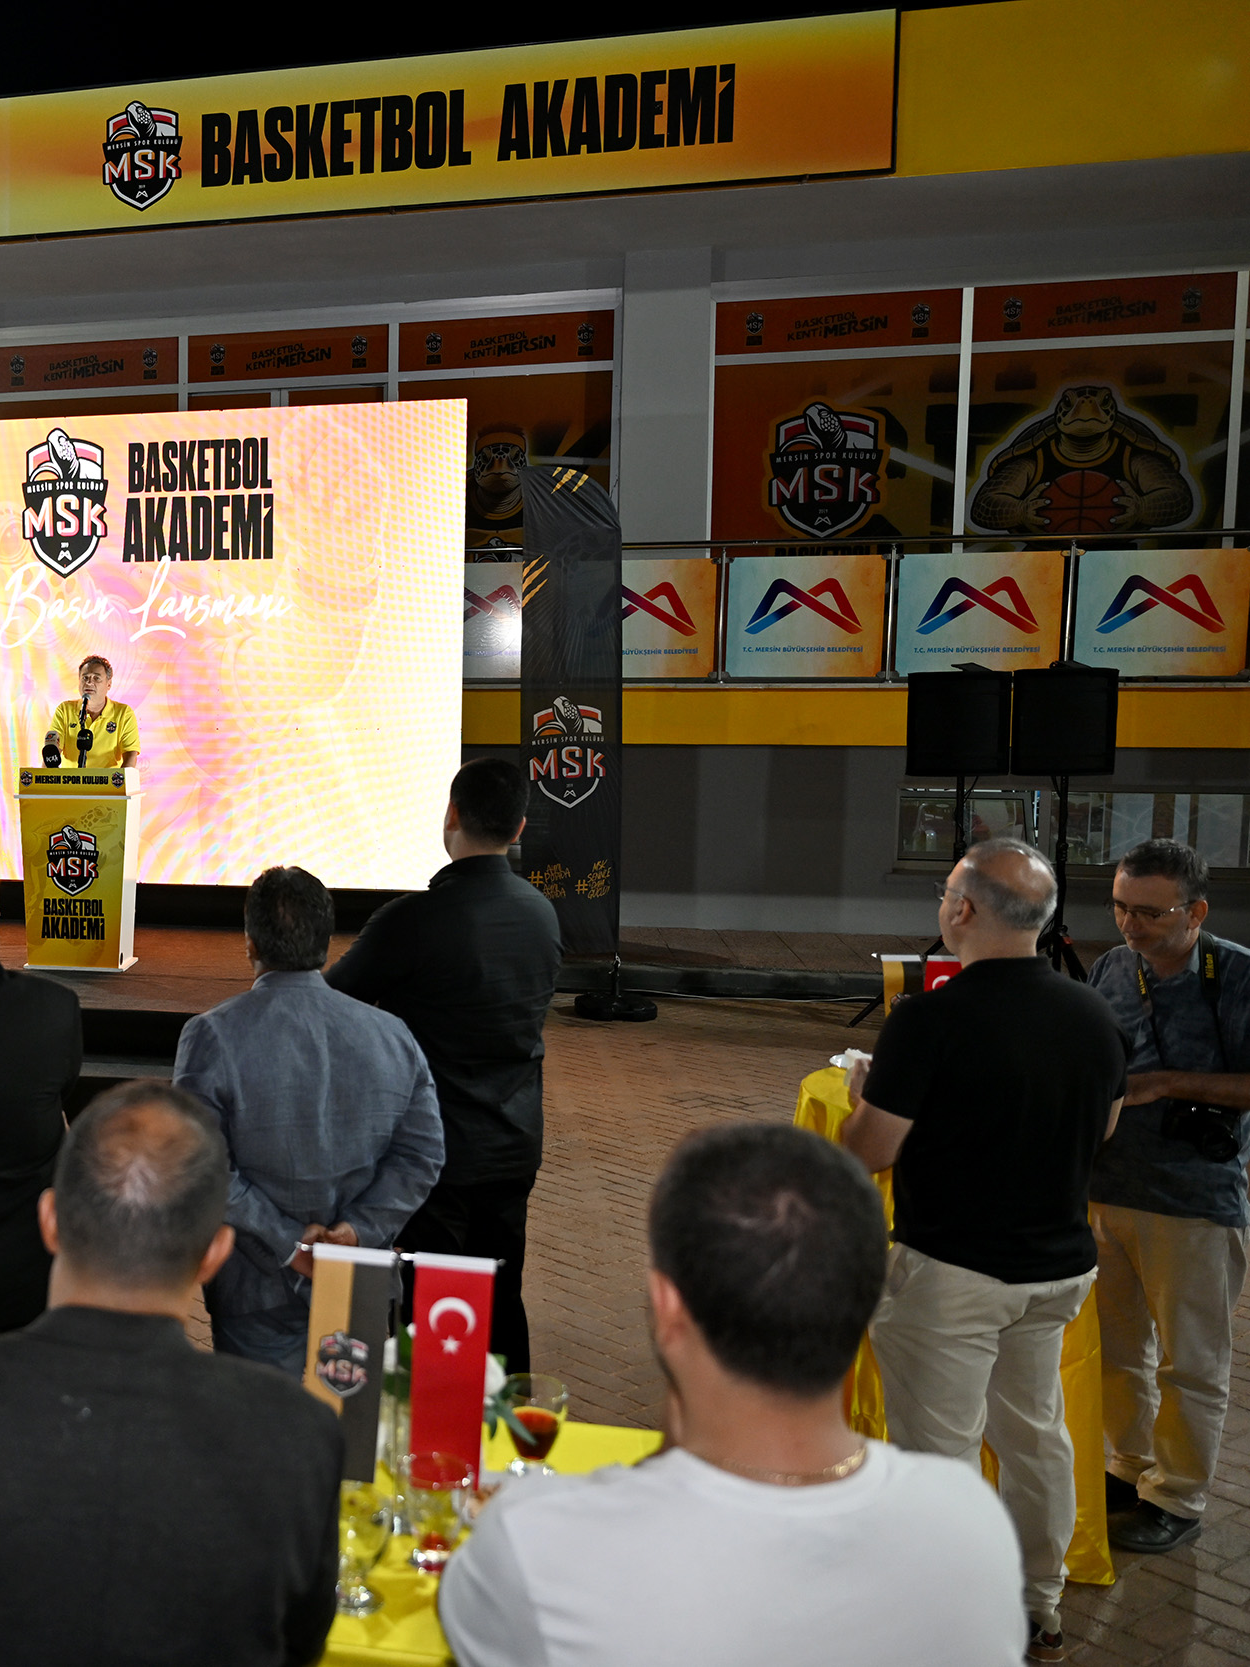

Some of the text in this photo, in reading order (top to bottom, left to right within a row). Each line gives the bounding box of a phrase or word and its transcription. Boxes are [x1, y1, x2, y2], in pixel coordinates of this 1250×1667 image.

[201, 89, 472, 188] BASKETBOL
[105, 149, 180, 184] MSK
[128, 437, 272, 493] BASKETBOL
[775, 454, 809, 463] MERSİN
[814, 452, 837, 460] SPOR
[56, 481, 73, 491] SPOR
[772, 464, 880, 505] MSK
[24, 494, 106, 539] MSK
[529, 746, 606, 780] MSK
[62, 775, 81, 784] SPOR
[48, 857, 97, 877] MSK
[43, 898, 104, 917] BASKETBOL
[1205, 953, 1215, 979] Nikon
